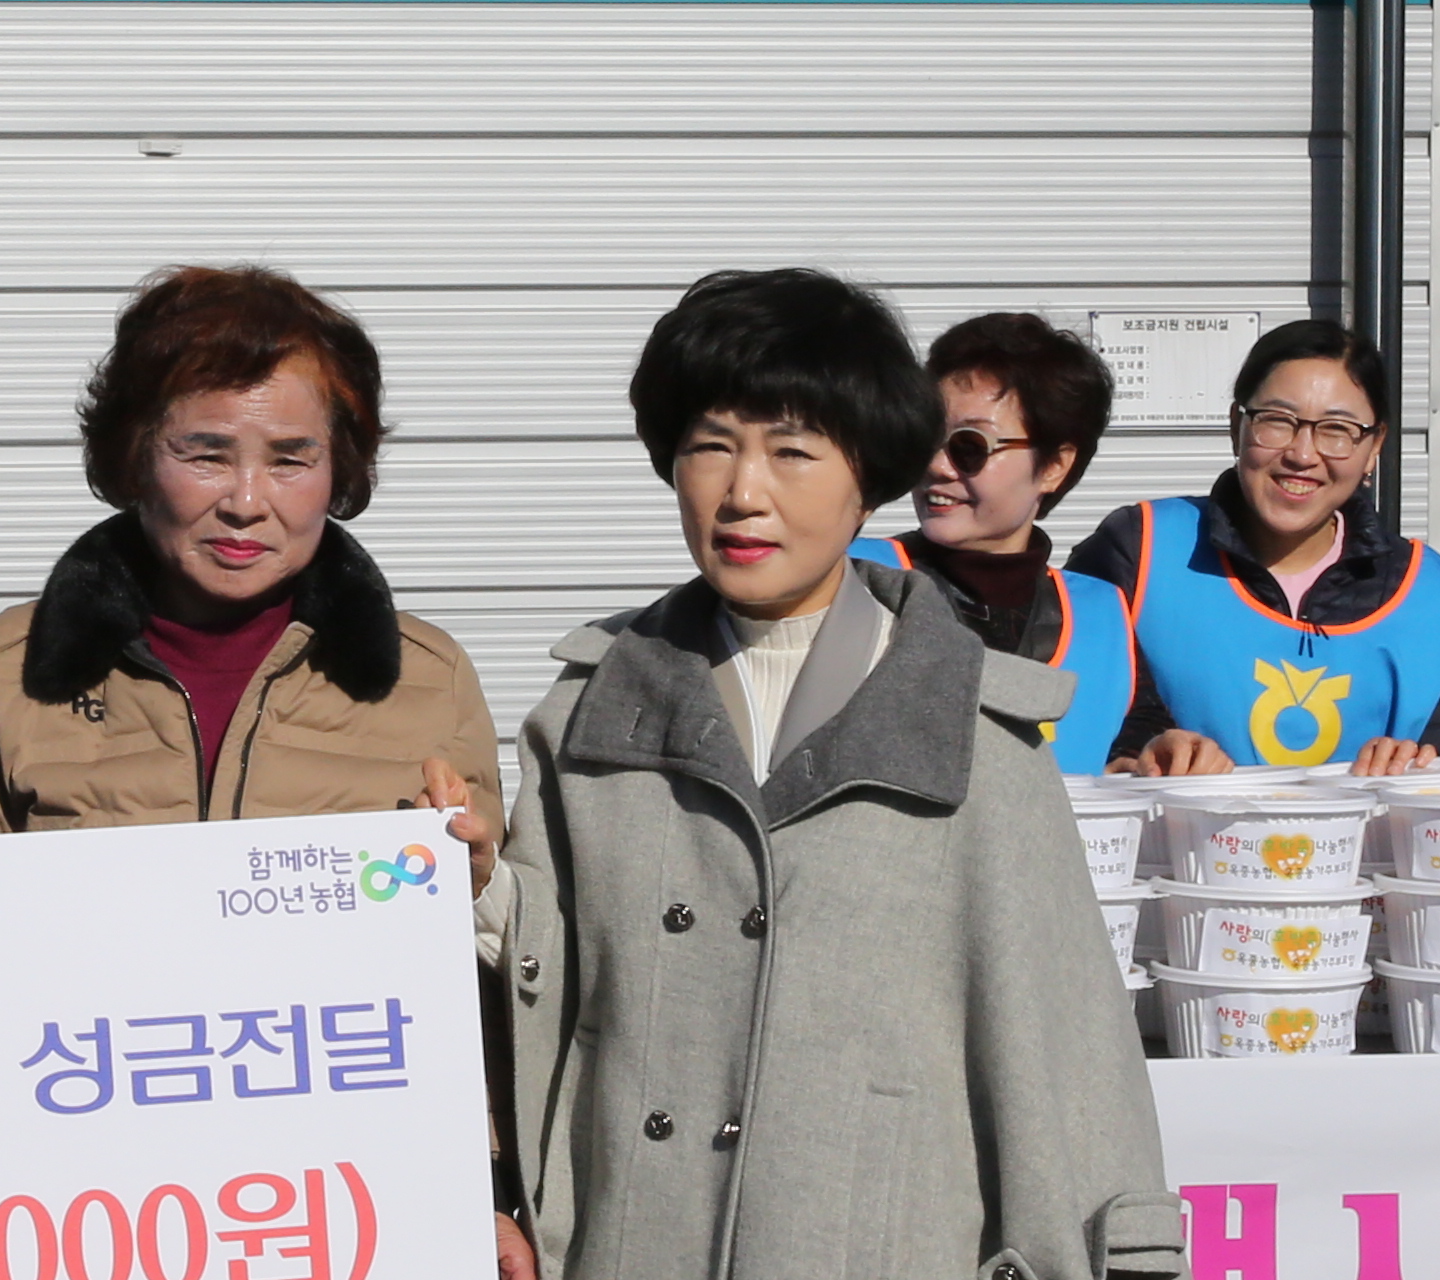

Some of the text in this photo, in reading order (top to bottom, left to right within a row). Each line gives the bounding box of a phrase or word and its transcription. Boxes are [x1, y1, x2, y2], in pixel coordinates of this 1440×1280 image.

[1122, 319, 1229, 331] 보조금지원 건립시설
[248, 843, 353, 881] 함께하는
[217, 878, 356, 918] 100년 농협
[19, 999, 413, 1117] 성금전달
